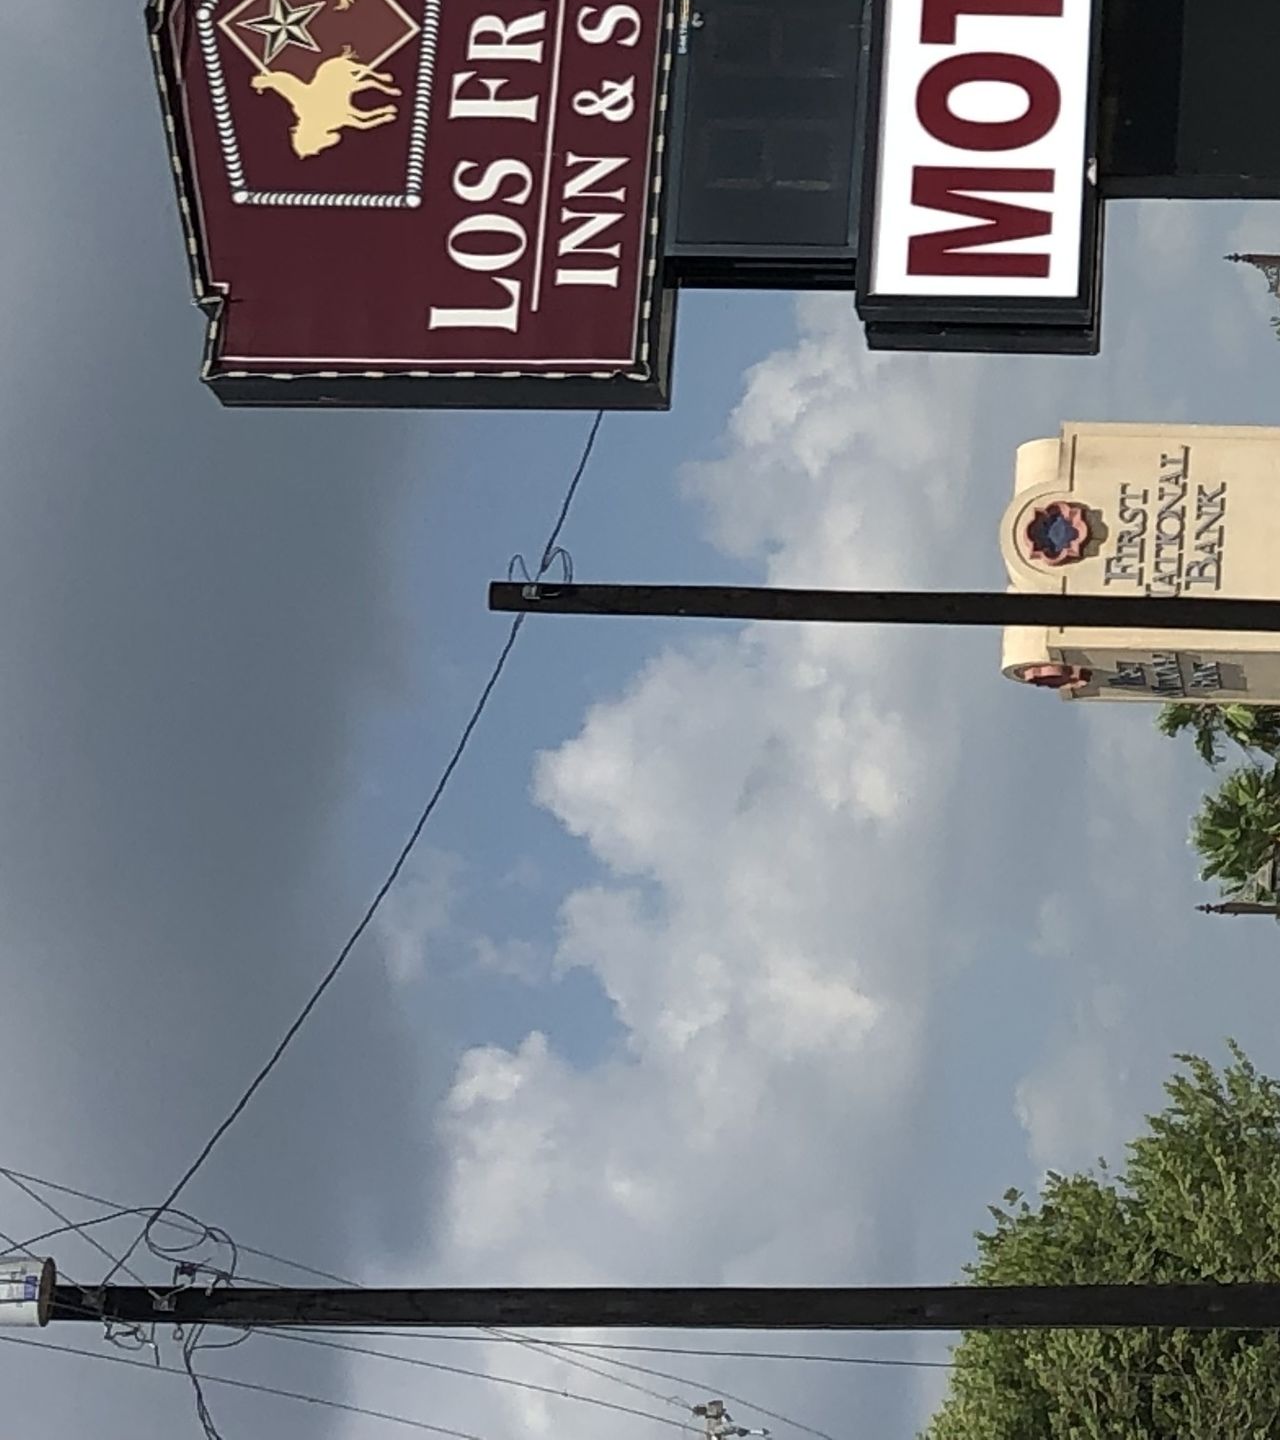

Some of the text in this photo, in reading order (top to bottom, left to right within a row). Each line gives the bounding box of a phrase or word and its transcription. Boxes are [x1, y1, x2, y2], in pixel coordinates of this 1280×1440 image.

[572, 75, 636, 123] &
[427, 157, 533, 333] LOS
[555, 152, 632, 289] INN
[1104, 482, 1149, 586] FIRST
[1184, 481, 1227, 591] BANK
